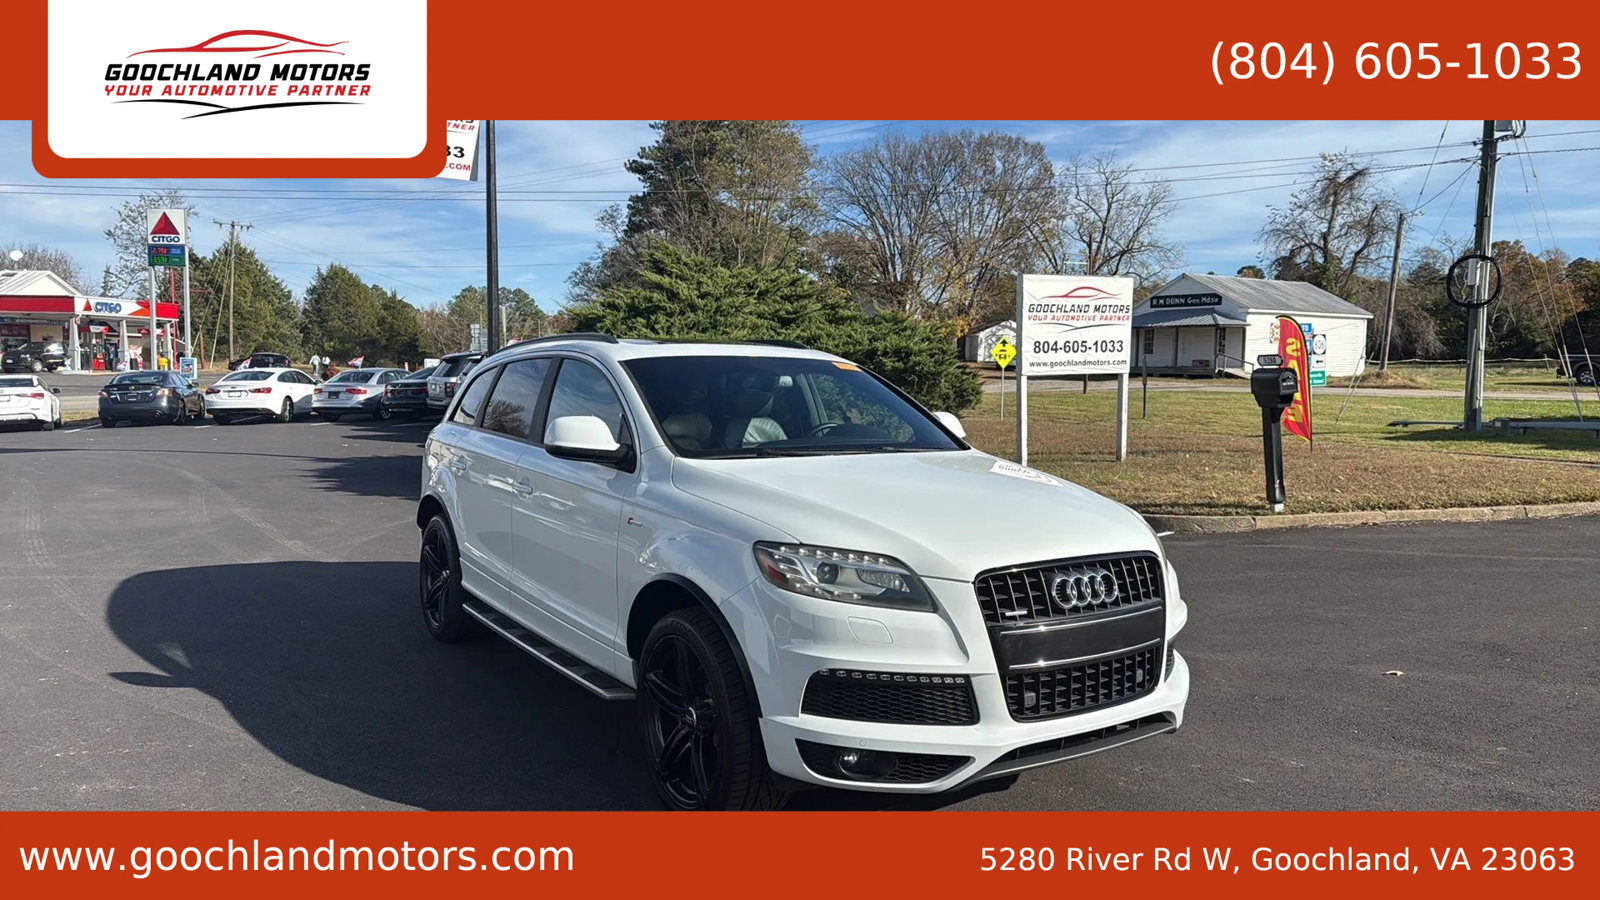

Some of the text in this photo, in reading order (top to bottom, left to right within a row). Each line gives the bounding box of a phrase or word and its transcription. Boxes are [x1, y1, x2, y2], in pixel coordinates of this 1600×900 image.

[447, 122, 475, 131] TNER
[446, 163, 471, 171] .COM
[151, 235, 181, 243] CITGO
[1165, 297, 1186, 305] DUNN
[94, 301, 122, 314] CITGO
[1028, 303, 1131, 314] GOOCHLAND MOTORS
[1033, 340, 1124, 354] 804-605-1033
[1029, 359, 1127, 369] www.goochlandmotors.com
